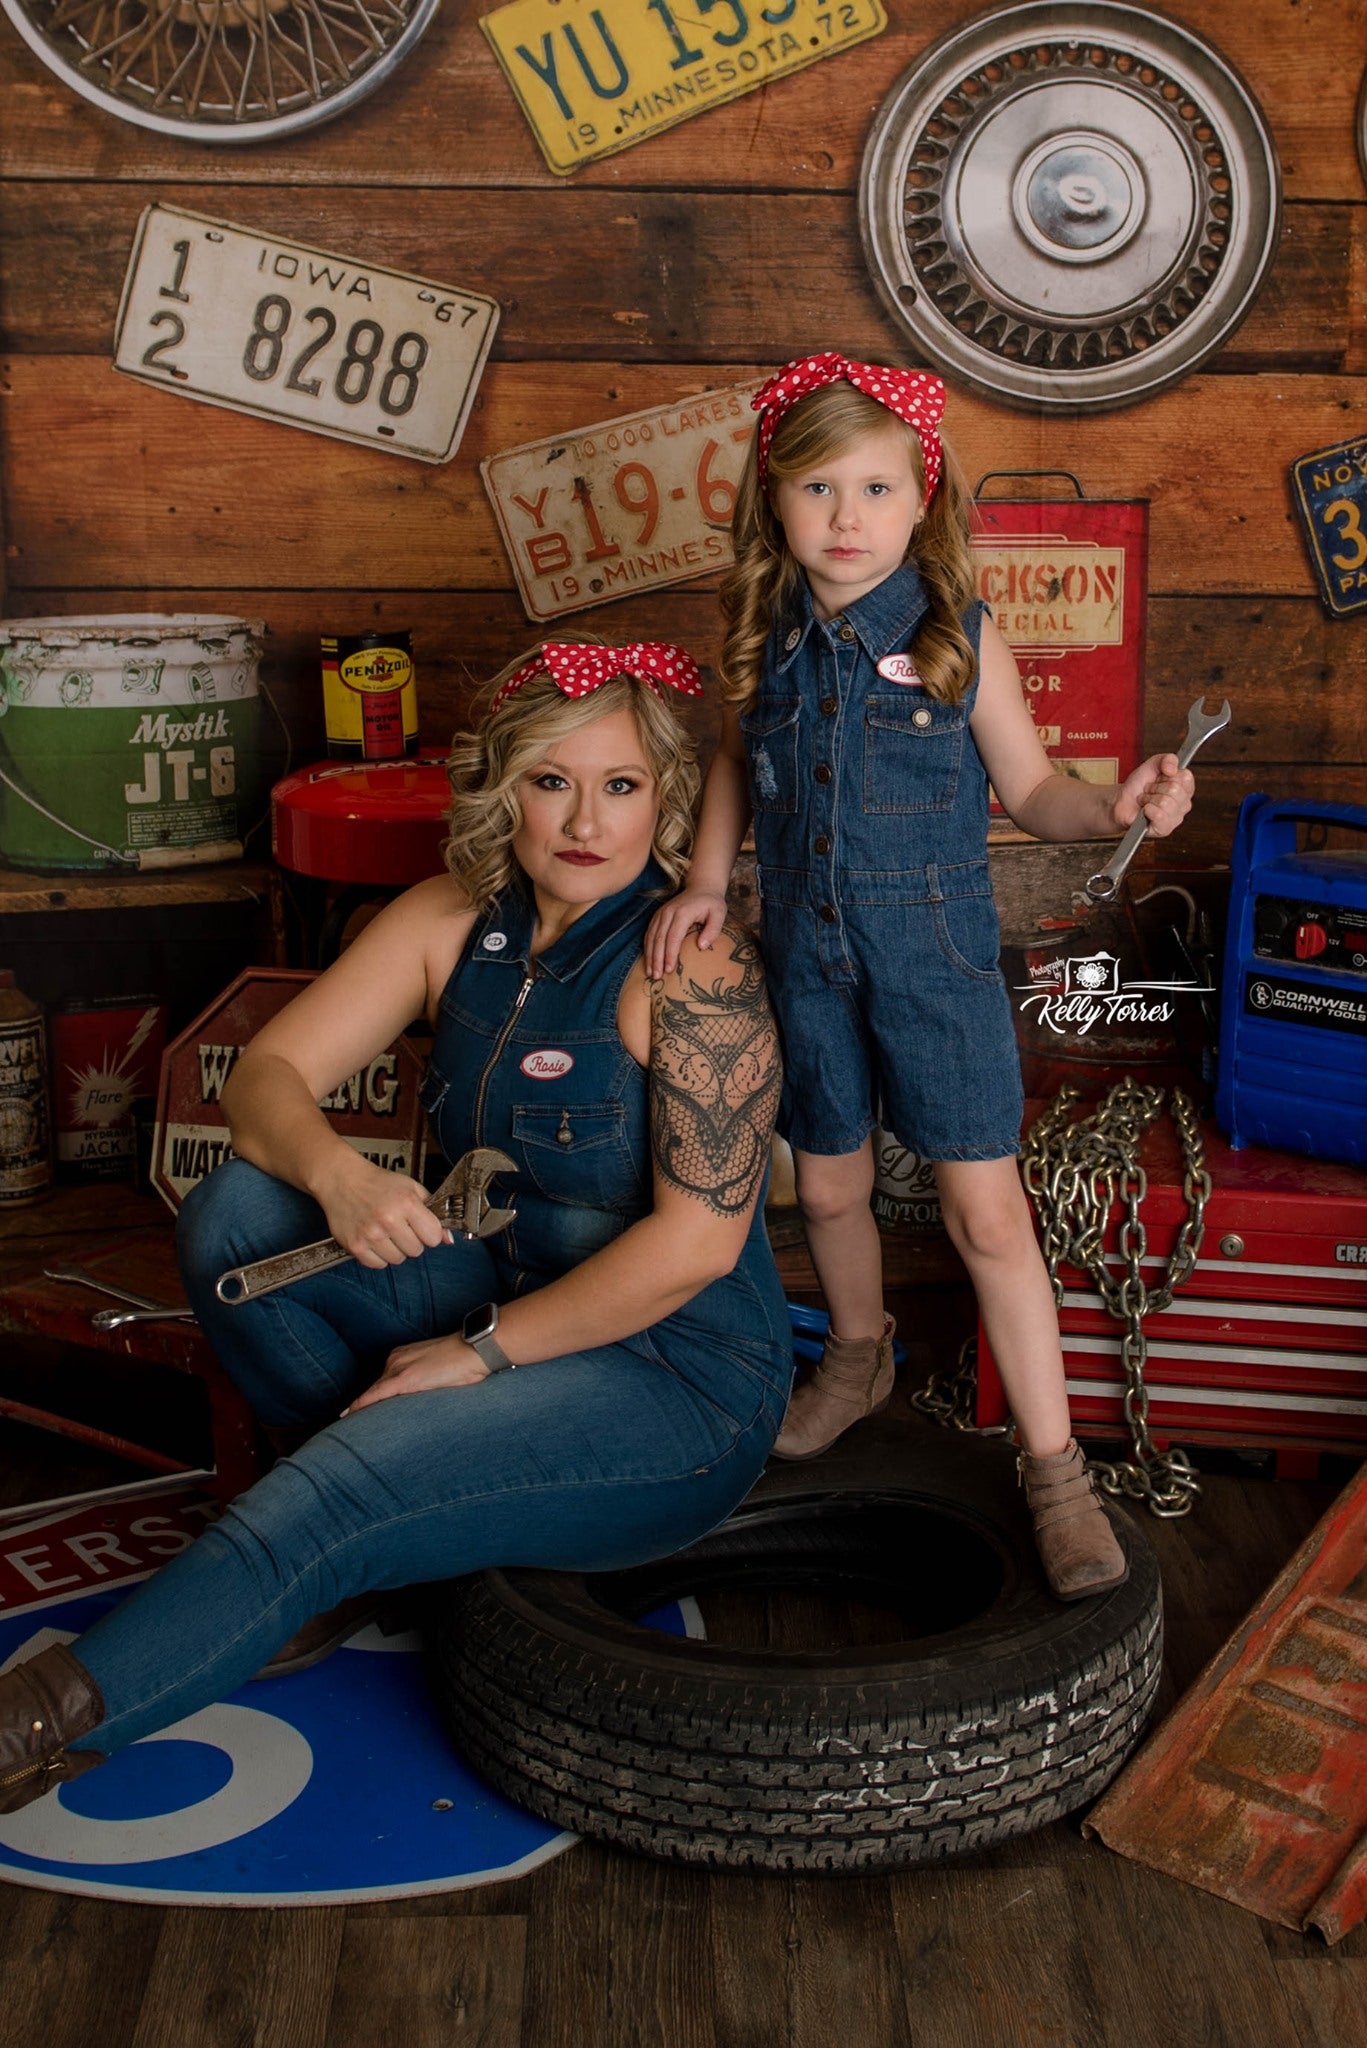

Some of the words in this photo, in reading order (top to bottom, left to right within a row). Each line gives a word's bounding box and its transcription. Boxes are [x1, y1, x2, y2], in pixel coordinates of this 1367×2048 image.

[516, 10, 630, 121] YU
[566, 123, 599, 152] 19
[618, 31, 802, 129] MINNESOTA
[815, 4, 861, 37] 72
[257, 249, 374, 302] IOWA
[434, 301, 478, 328] 67
[242, 294, 429, 417] 8288
[659, 396, 742, 437] LAKES
[571, 426, 753, 562] 19-6
[550, 575, 580, 602] 19
[603, 534, 734, 586] MINNES
[978, 564, 1117, 604] CKSON
[996, 613, 1074, 632] ECIAL
[344, 658, 411, 678] PENNZOIL
[129, 709, 231, 750] Mystik
[1067, 731, 1109, 740] GALLONS
[125, 746, 236, 804] JT-6
[1306, 911, 1320, 920] OFF
[1272, 998, 1323, 1014] QUALITY
[1327, 1008, 1367, 1022] TOOLS
[1274, 989, 1367, 1014] CORNWELL
[529, 1055, 566, 1073] Rosie
[85, 1089, 122, 1111] Flare
[75, 1141, 121, 1159] JACK
